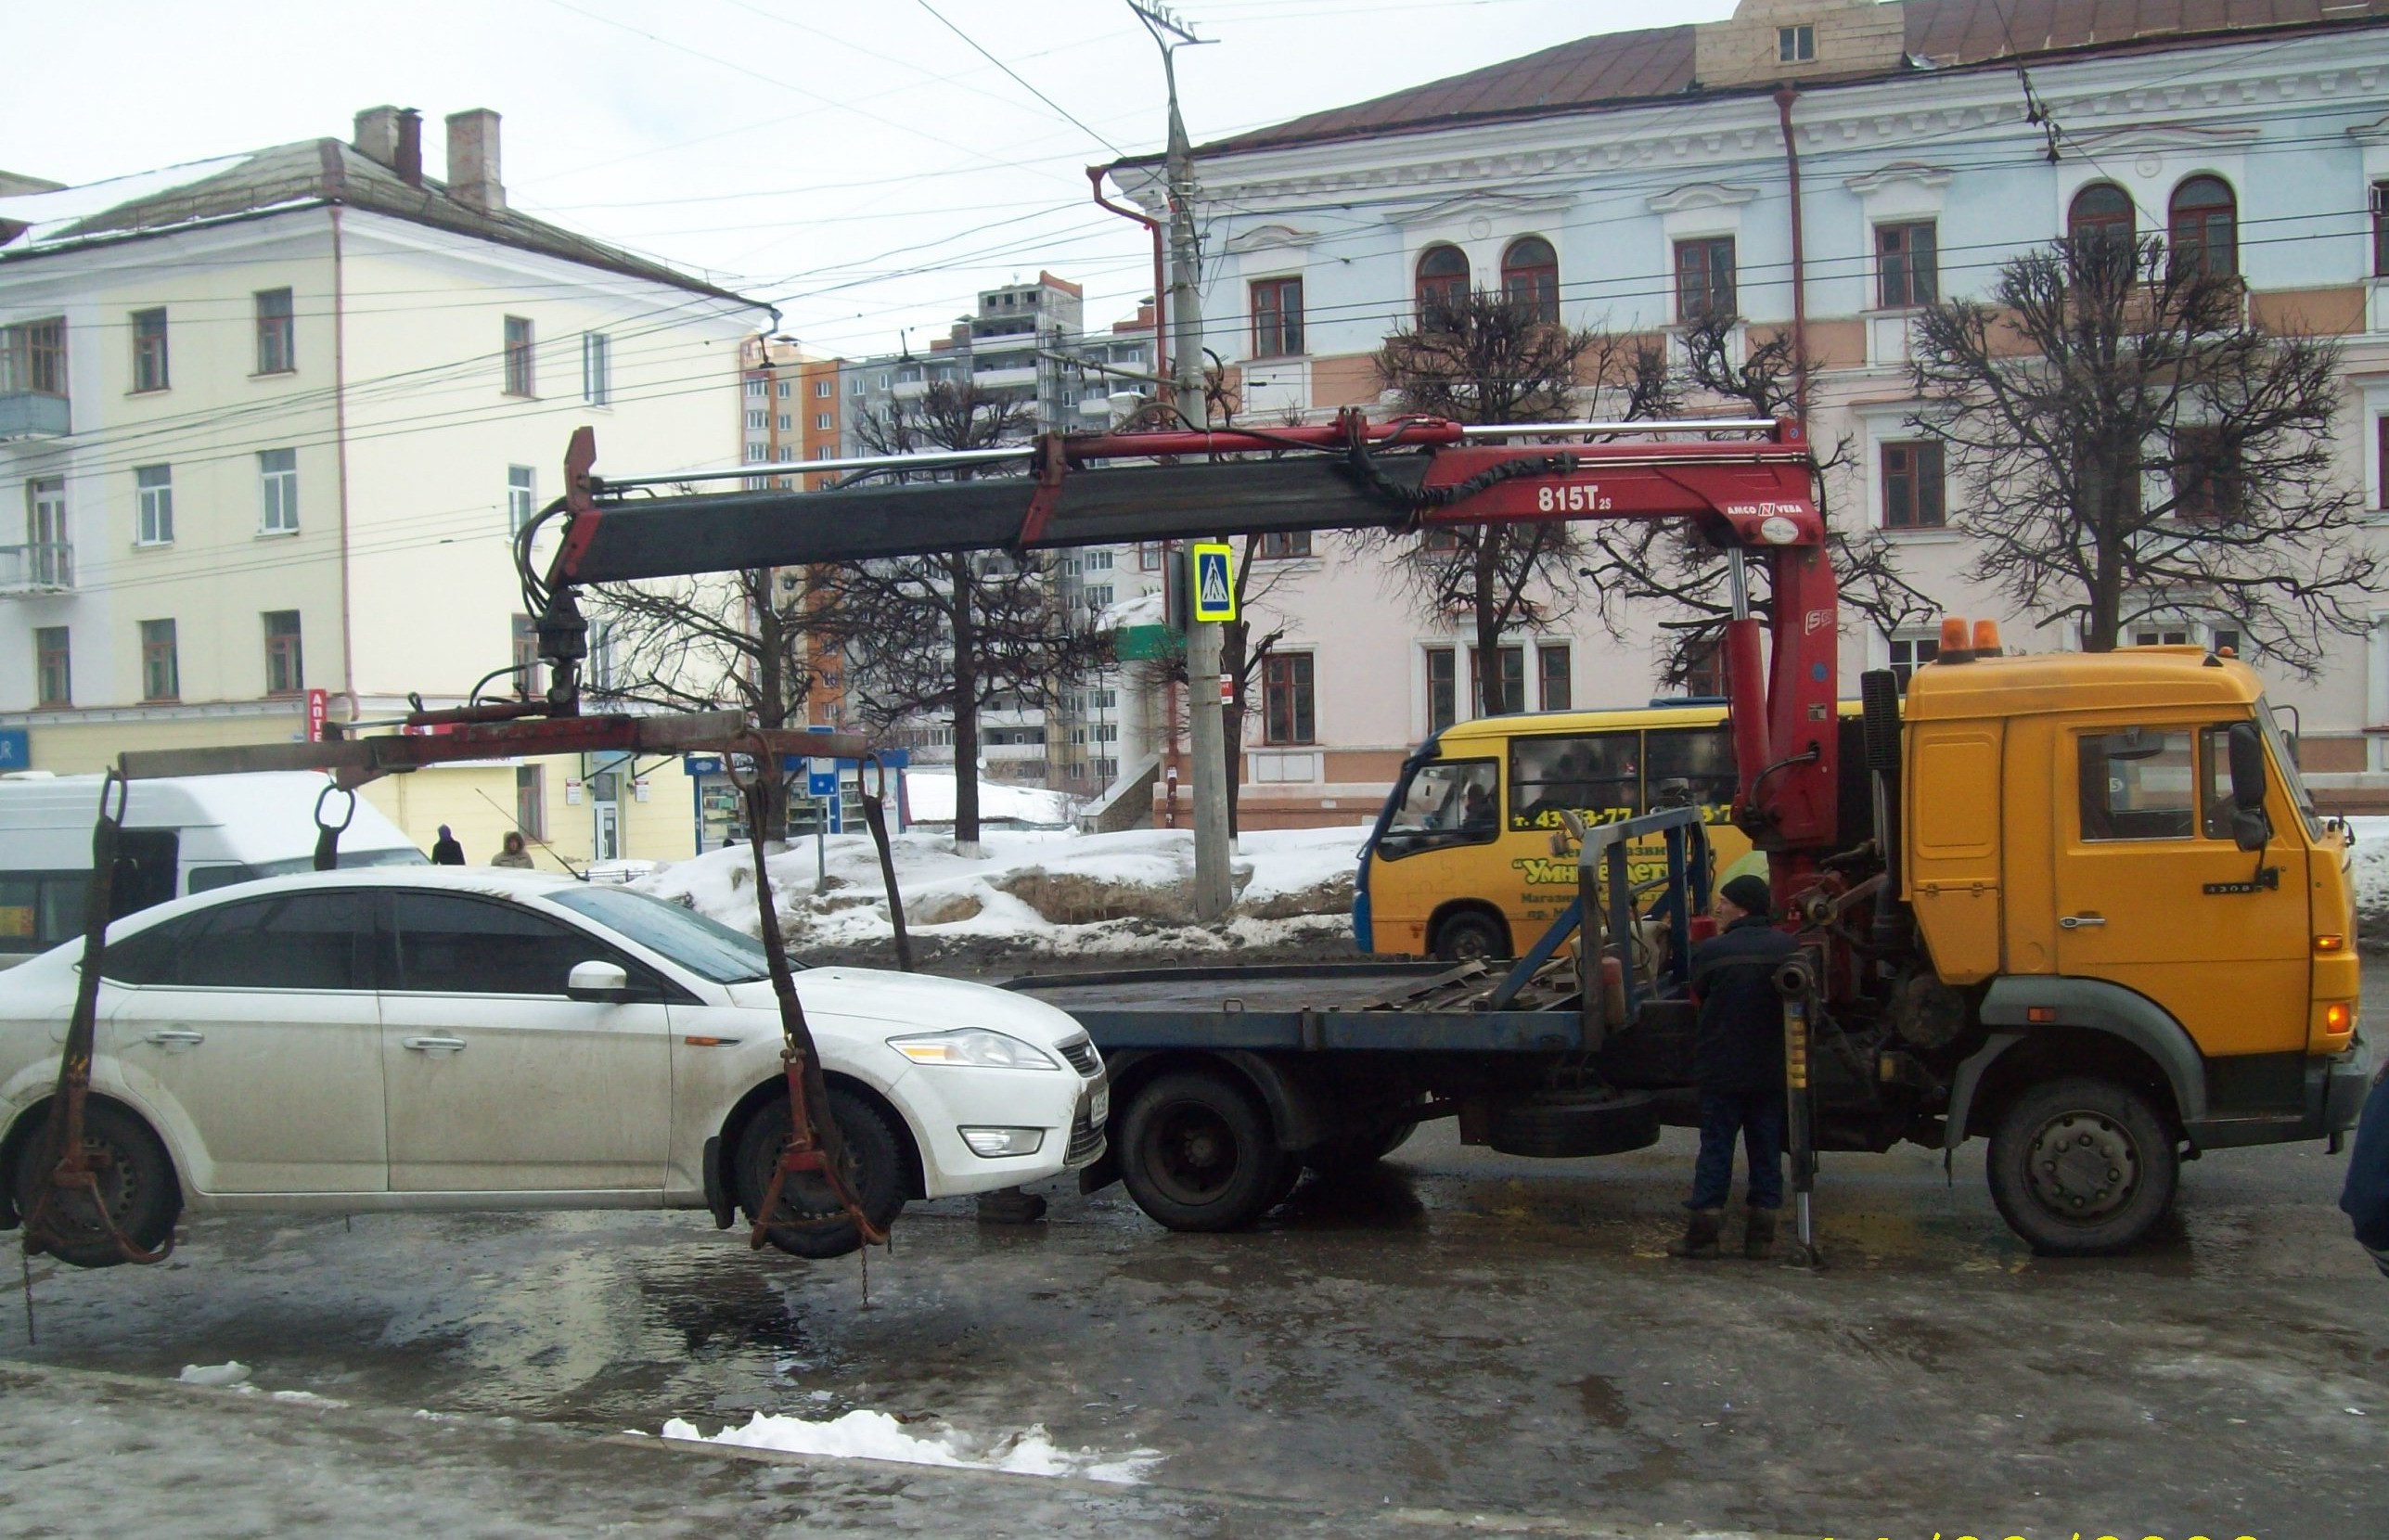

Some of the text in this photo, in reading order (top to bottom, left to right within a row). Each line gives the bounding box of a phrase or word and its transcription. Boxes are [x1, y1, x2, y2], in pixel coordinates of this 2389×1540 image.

[1538, 485, 1612, 511] 815T 2S
[1728, 506, 1756, 514] AMCO
[1776, 504, 1803, 513] VEBA
[313, 693, 323, 742] АПТЕ
